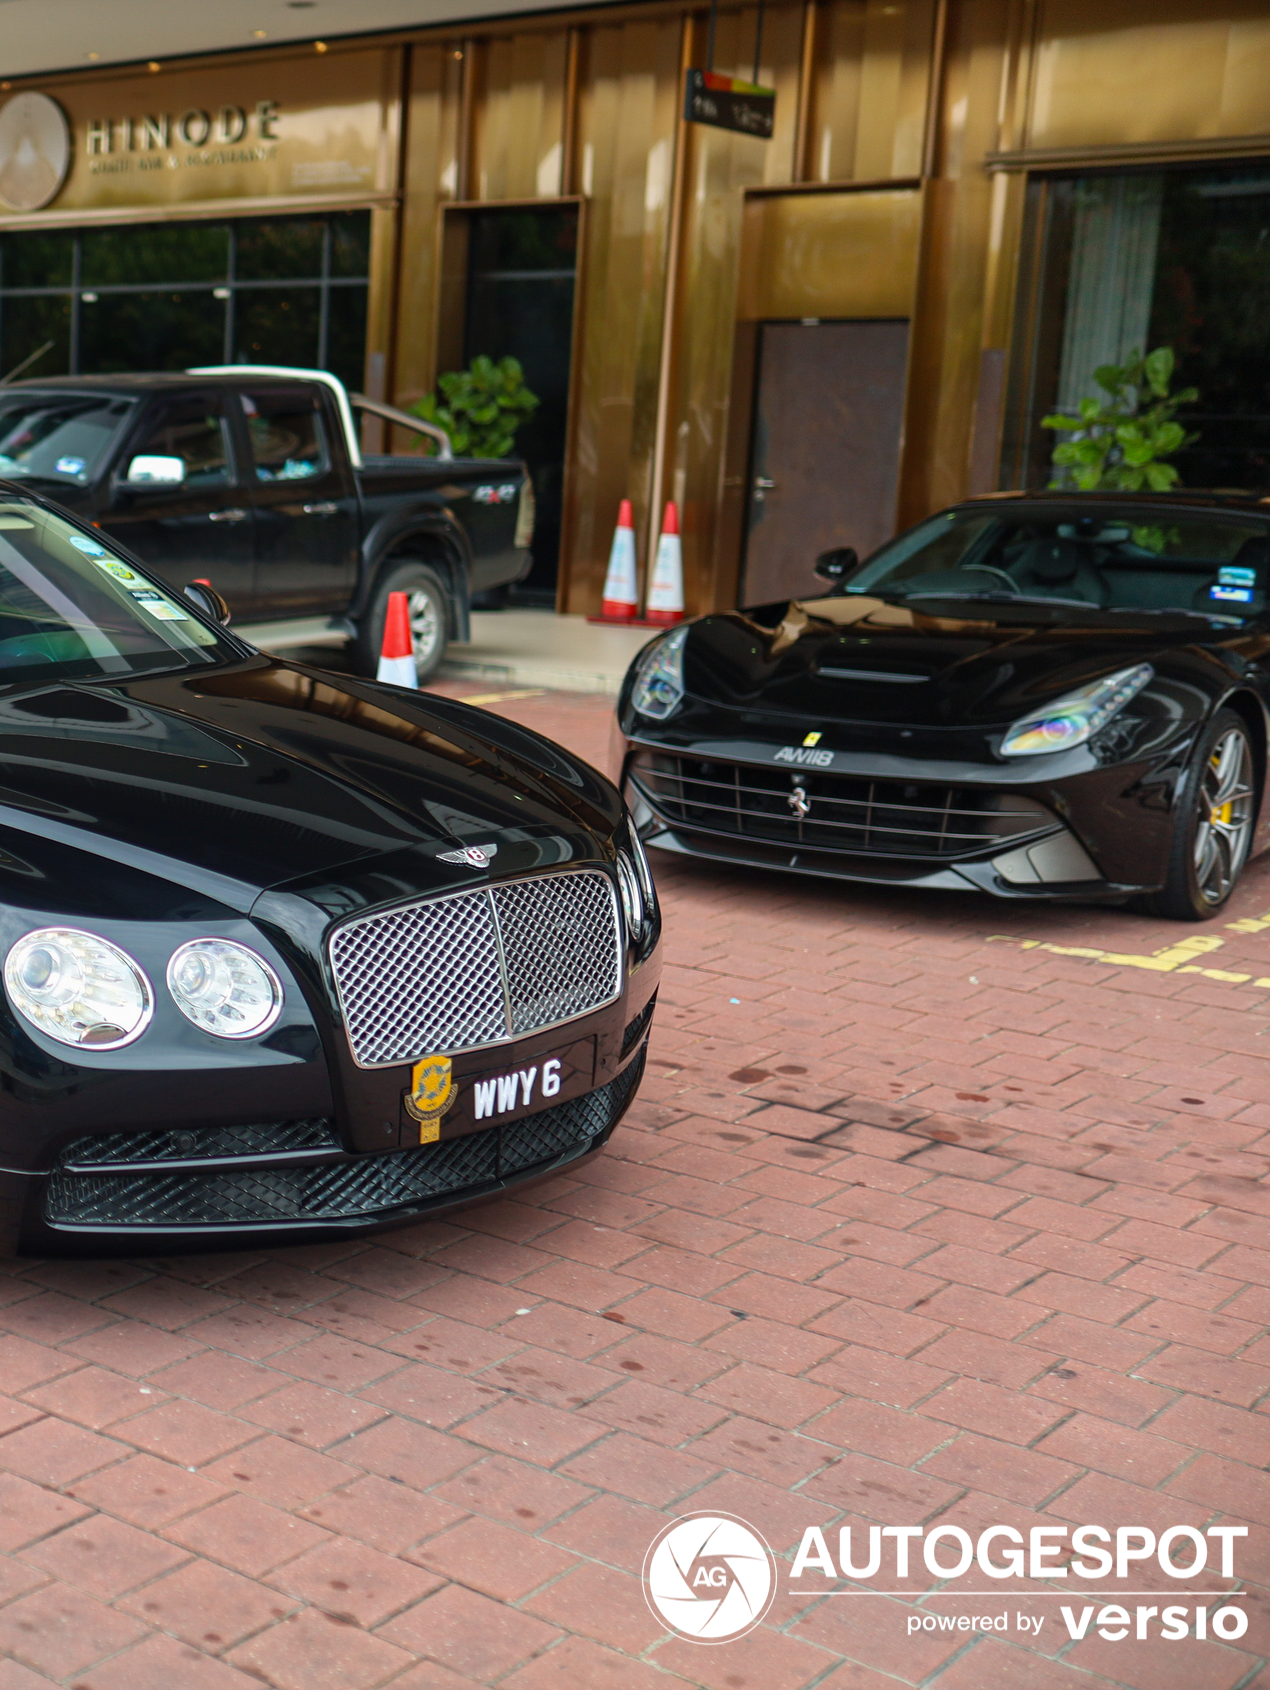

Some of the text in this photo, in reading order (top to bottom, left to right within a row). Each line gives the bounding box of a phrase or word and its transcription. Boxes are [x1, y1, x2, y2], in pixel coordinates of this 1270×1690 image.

[85, 101, 280, 155] HINODE
[474, 1065, 537, 1120] WWY
[542, 1058, 562, 1098] 6
